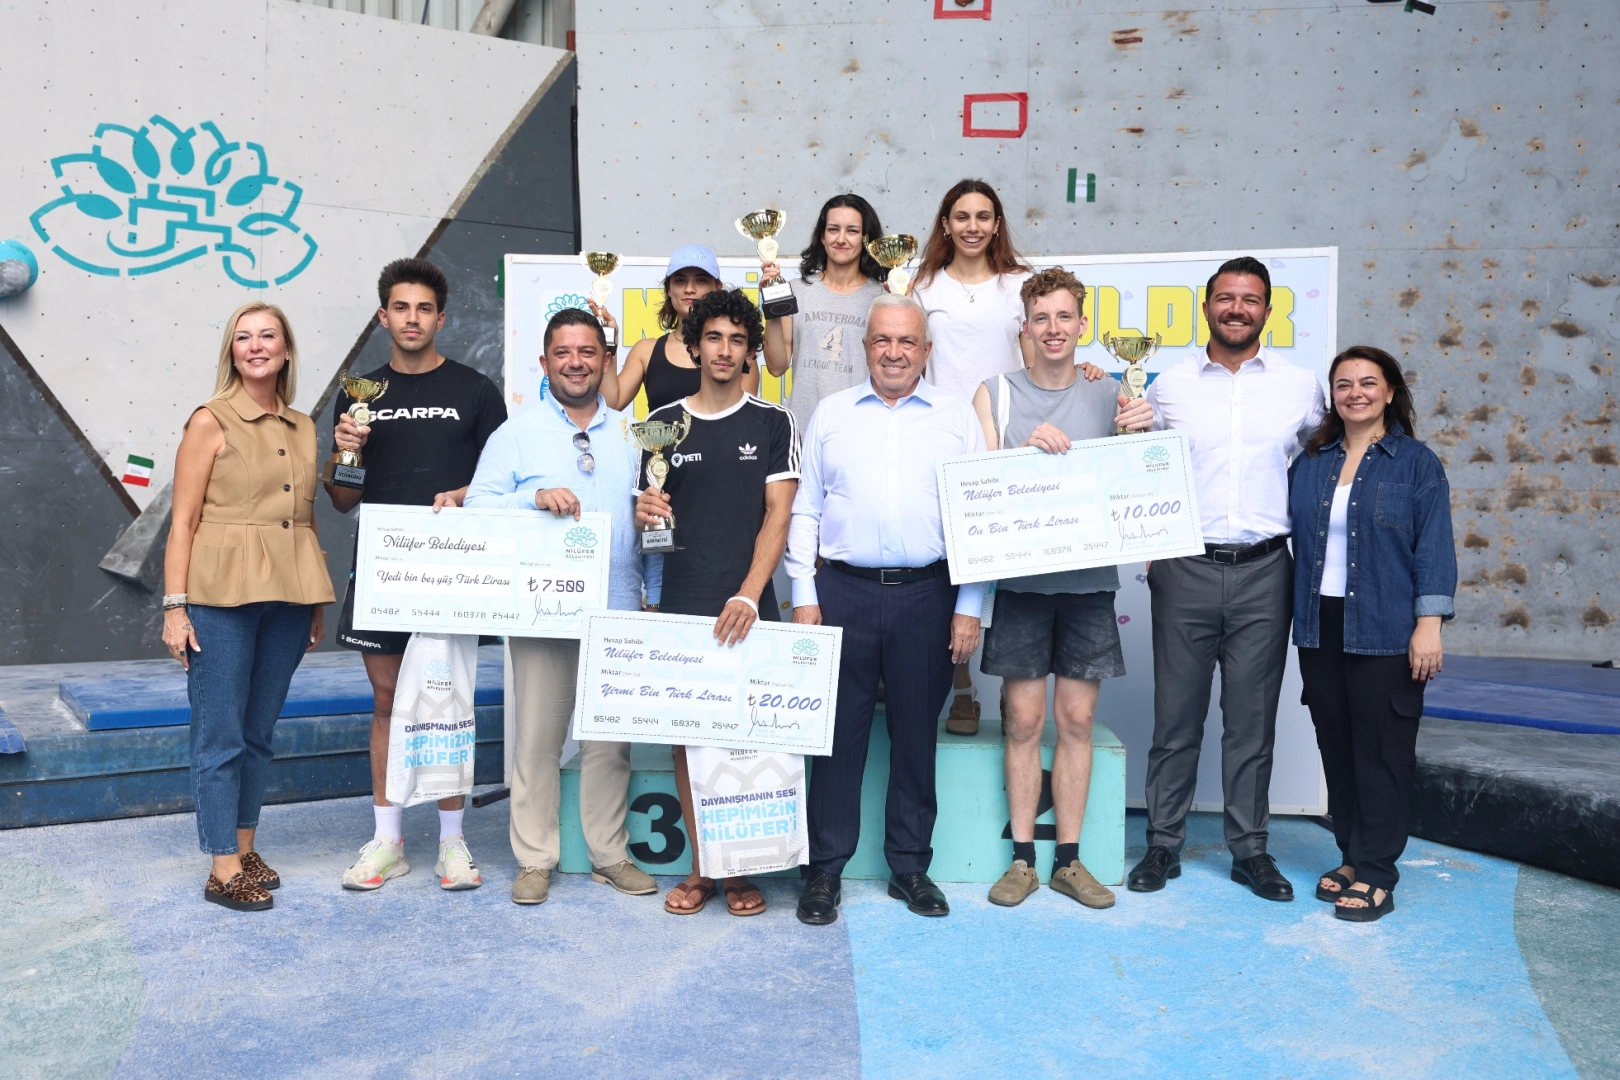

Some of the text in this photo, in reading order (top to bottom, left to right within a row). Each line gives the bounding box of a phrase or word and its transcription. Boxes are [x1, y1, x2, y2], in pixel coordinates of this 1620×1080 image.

[819, 323, 844, 361] 4
[833, 361, 854, 374] TEAM
[683, 453, 702, 462] YETI
[963, 482, 1061, 501] Nilüfer Belediyesi
[968, 515, 1079, 536] On Bin Türk Lirası
[383, 534, 487, 554] Nilüfer Belediyesi
[1005, 551, 1032, 561] 55444
[1083, 541, 1109, 551] 25447
[377, 570, 511, 586] Yedi bin beş yüz Türk Lirası
[371, 607, 520, 620] 05482 55444 160378 25447
[345, 636, 381, 649] SCARPA
[604, 647, 704, 665] Nilüfer Belediyesi
[601, 683, 733, 702] Yirmi Bin Türk Lirası
[632, 717, 659, 725] 55444
[671, 719, 700, 728] 160378
[712, 722, 739, 730] 25447
[701, 787, 797, 807] DAYANIŞMANIN SESİ
[701, 800, 797, 824] HEPİMİZİN
[629, 792, 686, 865] 3
